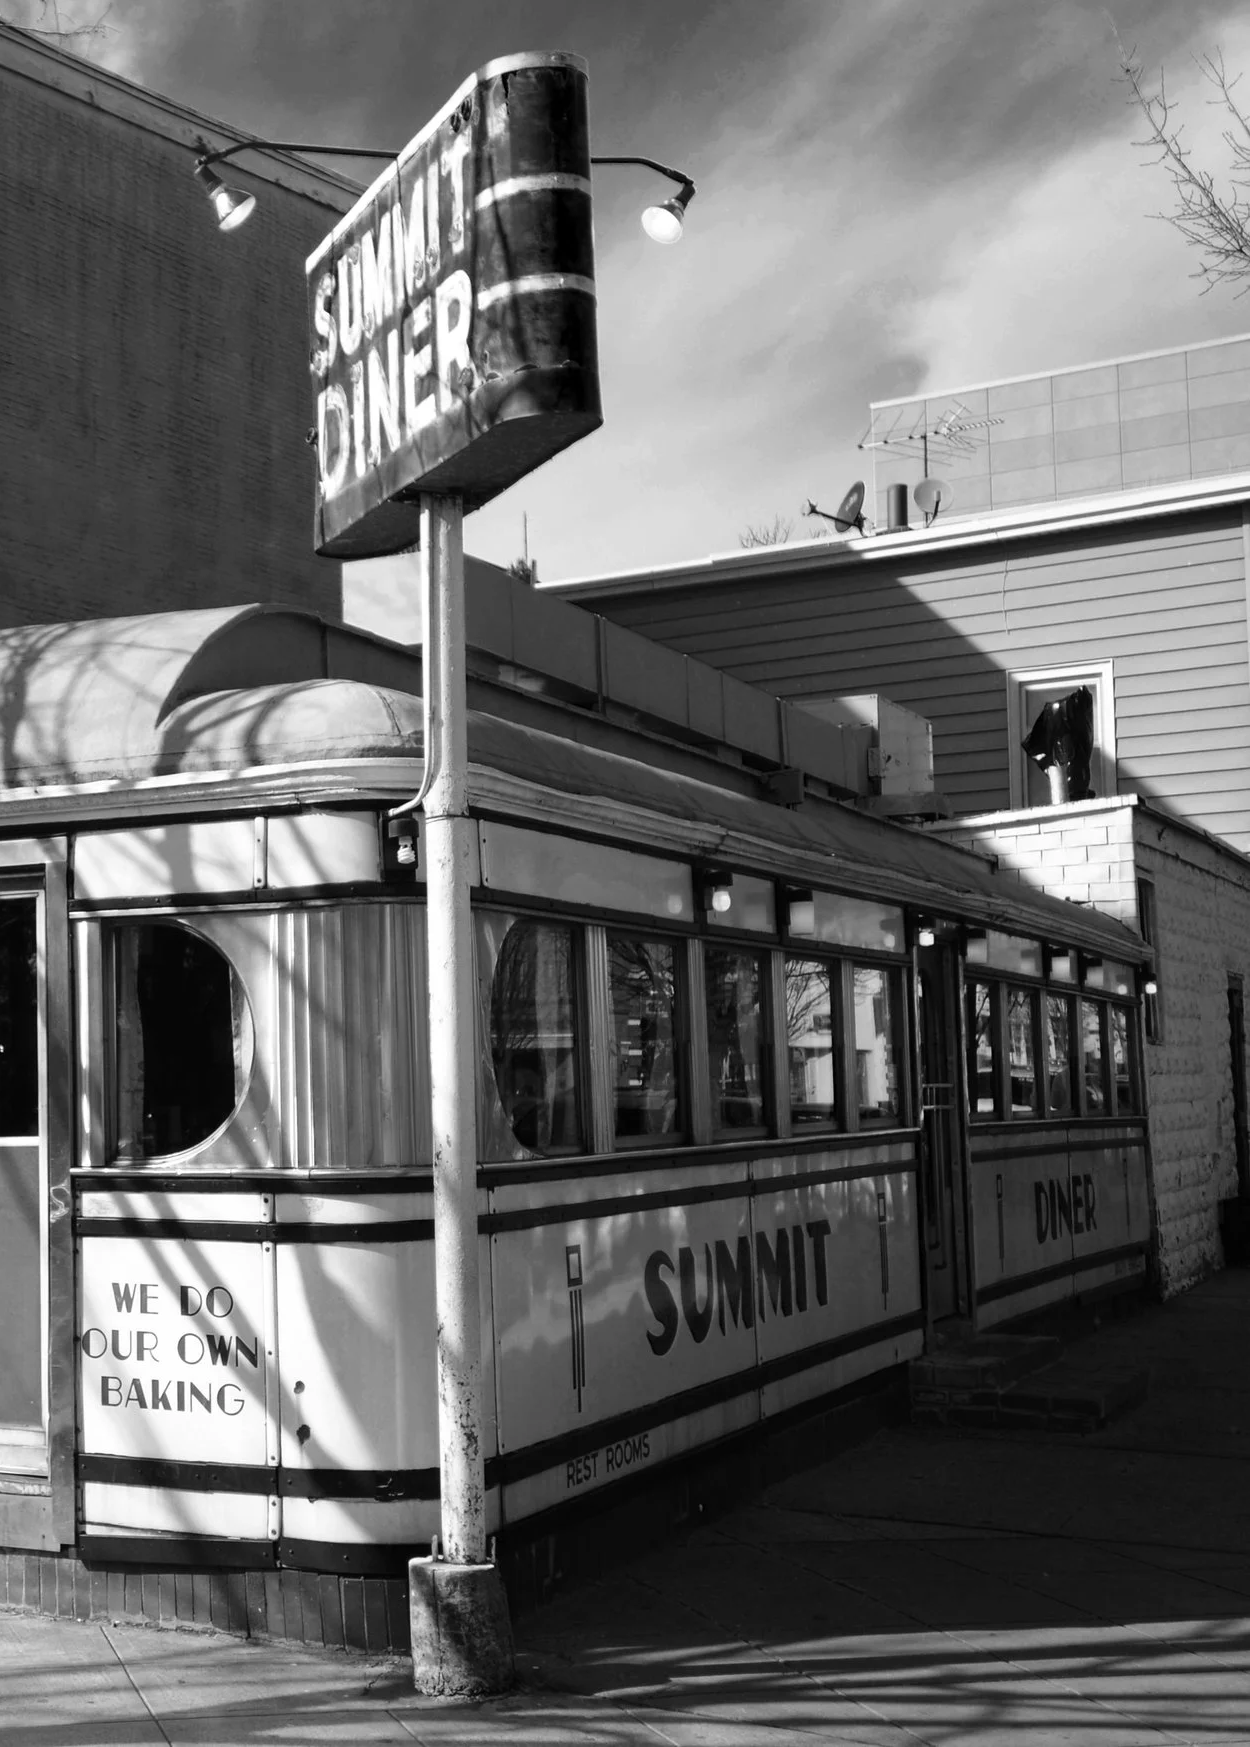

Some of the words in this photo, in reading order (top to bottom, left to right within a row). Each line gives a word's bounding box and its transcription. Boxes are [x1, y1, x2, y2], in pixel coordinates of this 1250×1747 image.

[310, 125, 472, 378] SUMMIT
[317, 270, 480, 500] DINER
[1034, 1174, 1098, 1244] DINER
[112, 1283, 158, 1315] WE
[180, 1286, 234, 1318] DO
[644, 1220, 832, 1357] SUMMIT
[82, 1328, 160, 1362] OUR
[177, 1333, 258, 1368] OWN
[101, 1376, 245, 1416] BAKING
[566, 1452, 598, 1488] REST
[606, 1434, 650, 1473] ROOMS
